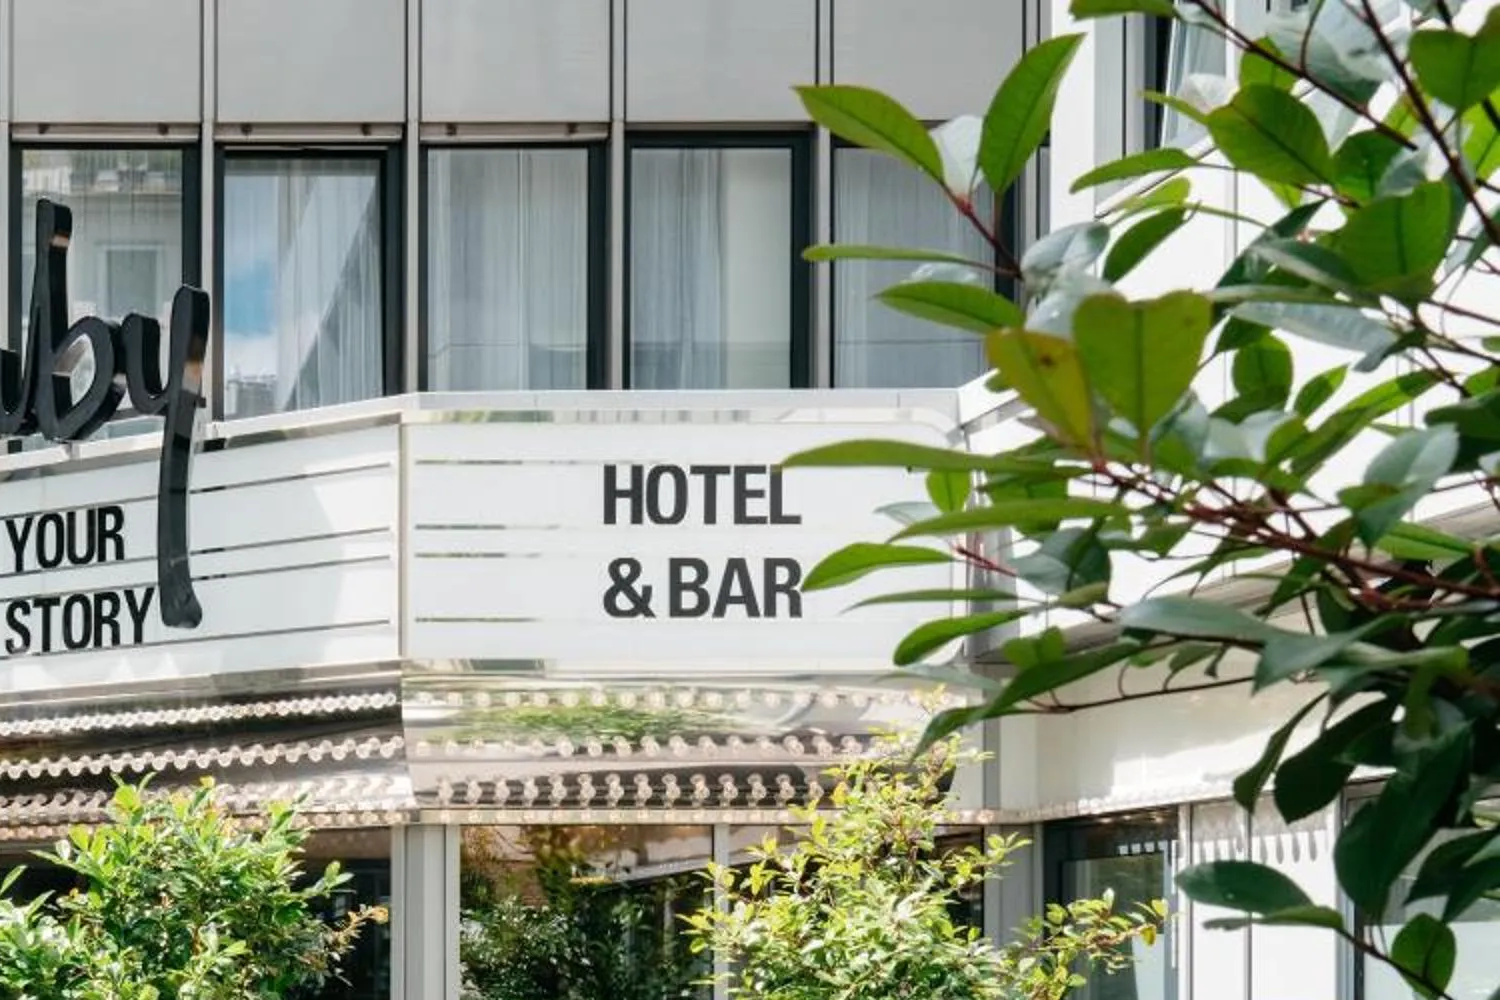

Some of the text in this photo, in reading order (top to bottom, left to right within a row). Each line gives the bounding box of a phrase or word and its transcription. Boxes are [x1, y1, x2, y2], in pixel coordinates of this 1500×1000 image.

[603, 464, 803, 525] HOTEL
[5, 505, 125, 573] YOUR
[603, 557, 803, 618] & BAR
[5, 587, 155, 655] STORY
